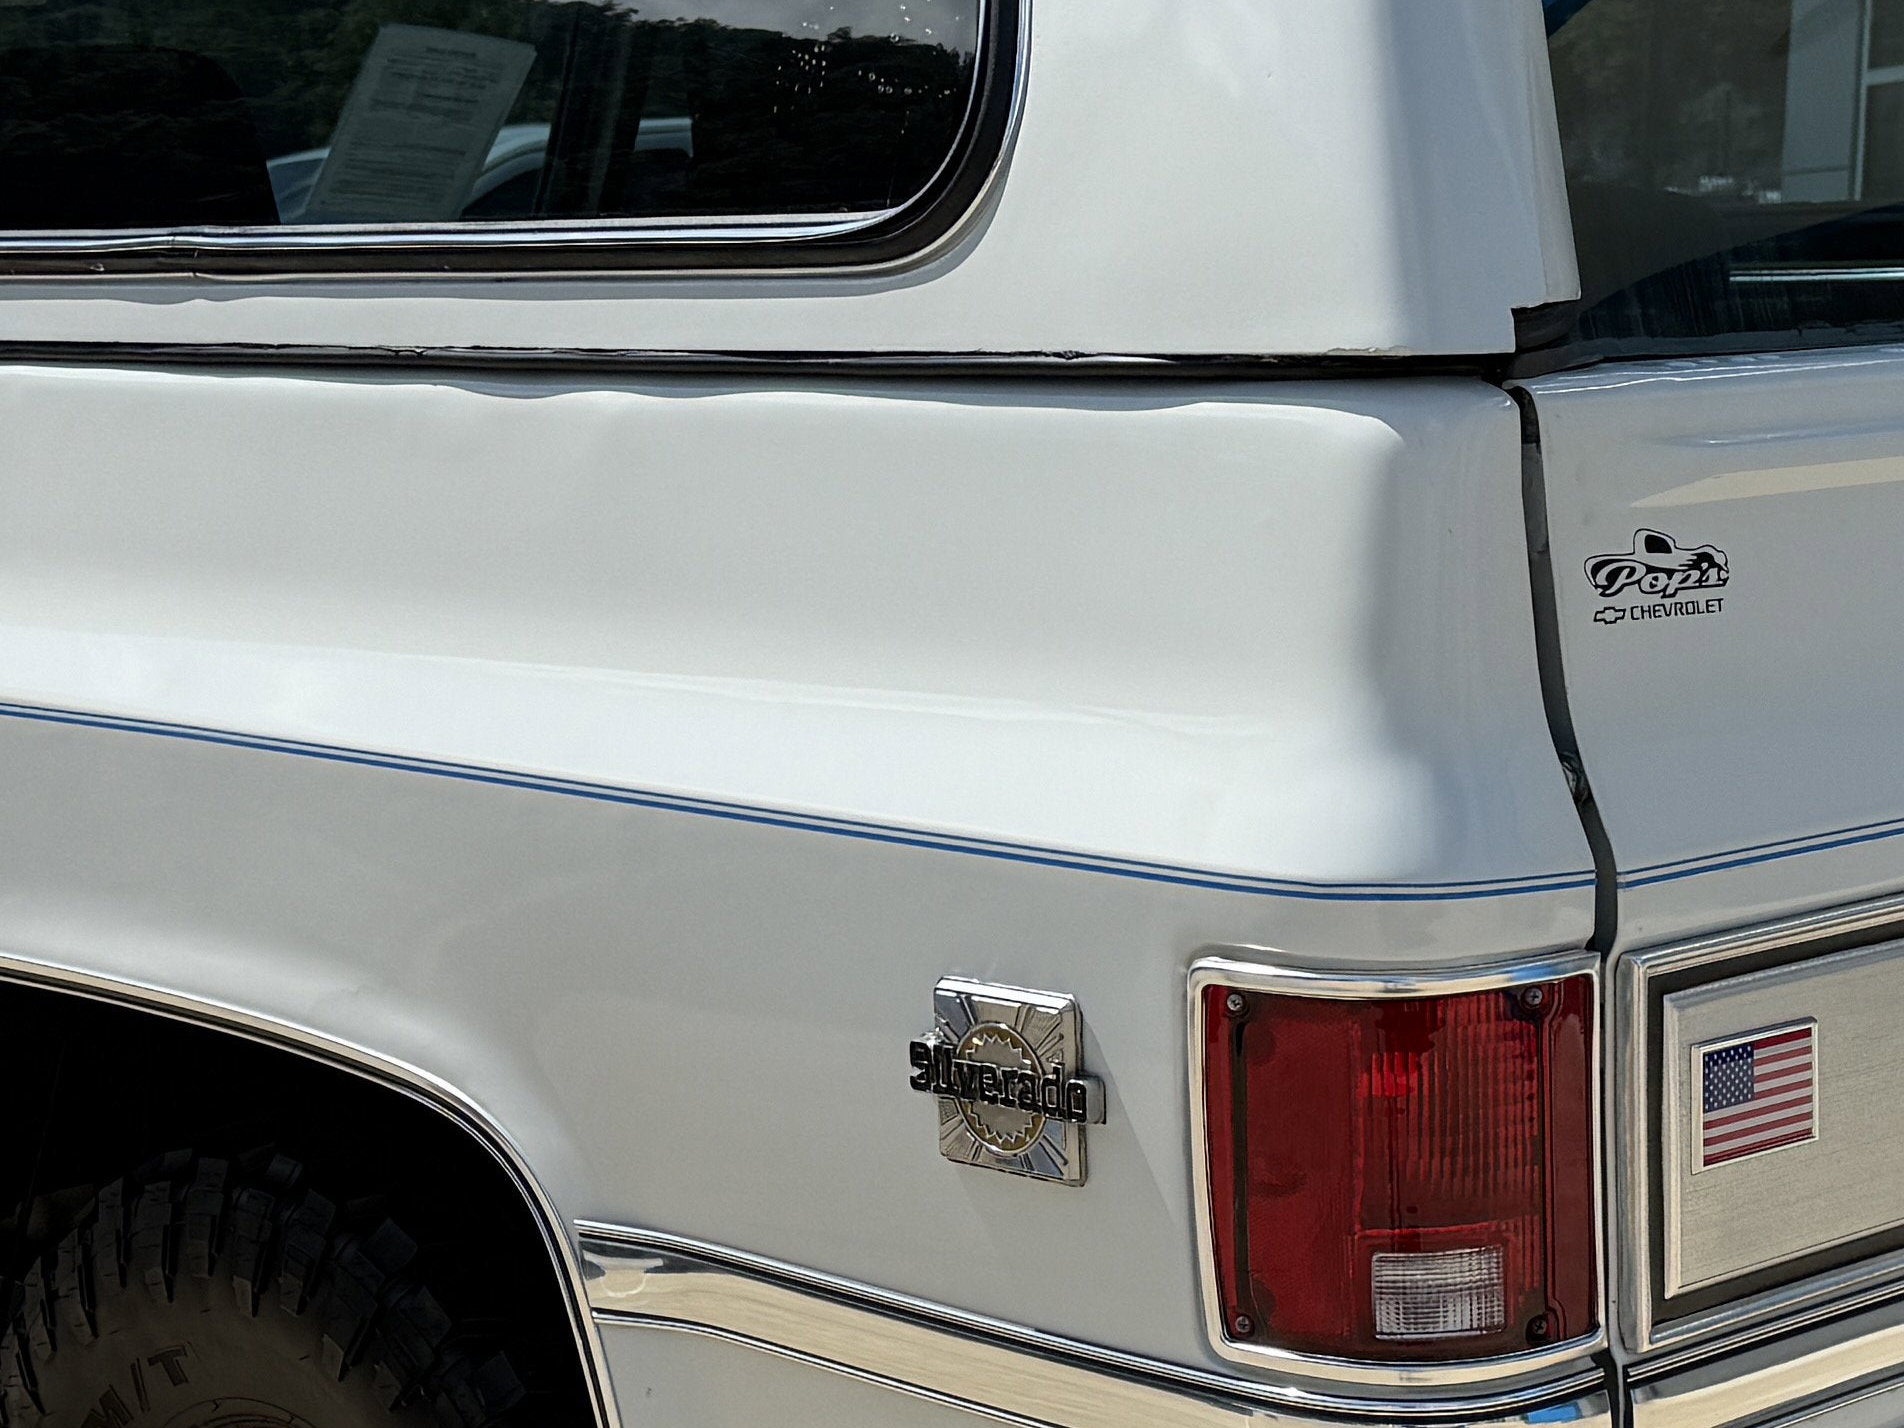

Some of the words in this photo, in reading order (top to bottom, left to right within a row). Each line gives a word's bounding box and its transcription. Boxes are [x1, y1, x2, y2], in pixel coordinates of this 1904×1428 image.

[1595, 560, 1730, 599] Pop's
[1630, 598, 1724, 621] CHEVROLET
[909, 1040, 1091, 1124] Silverado
